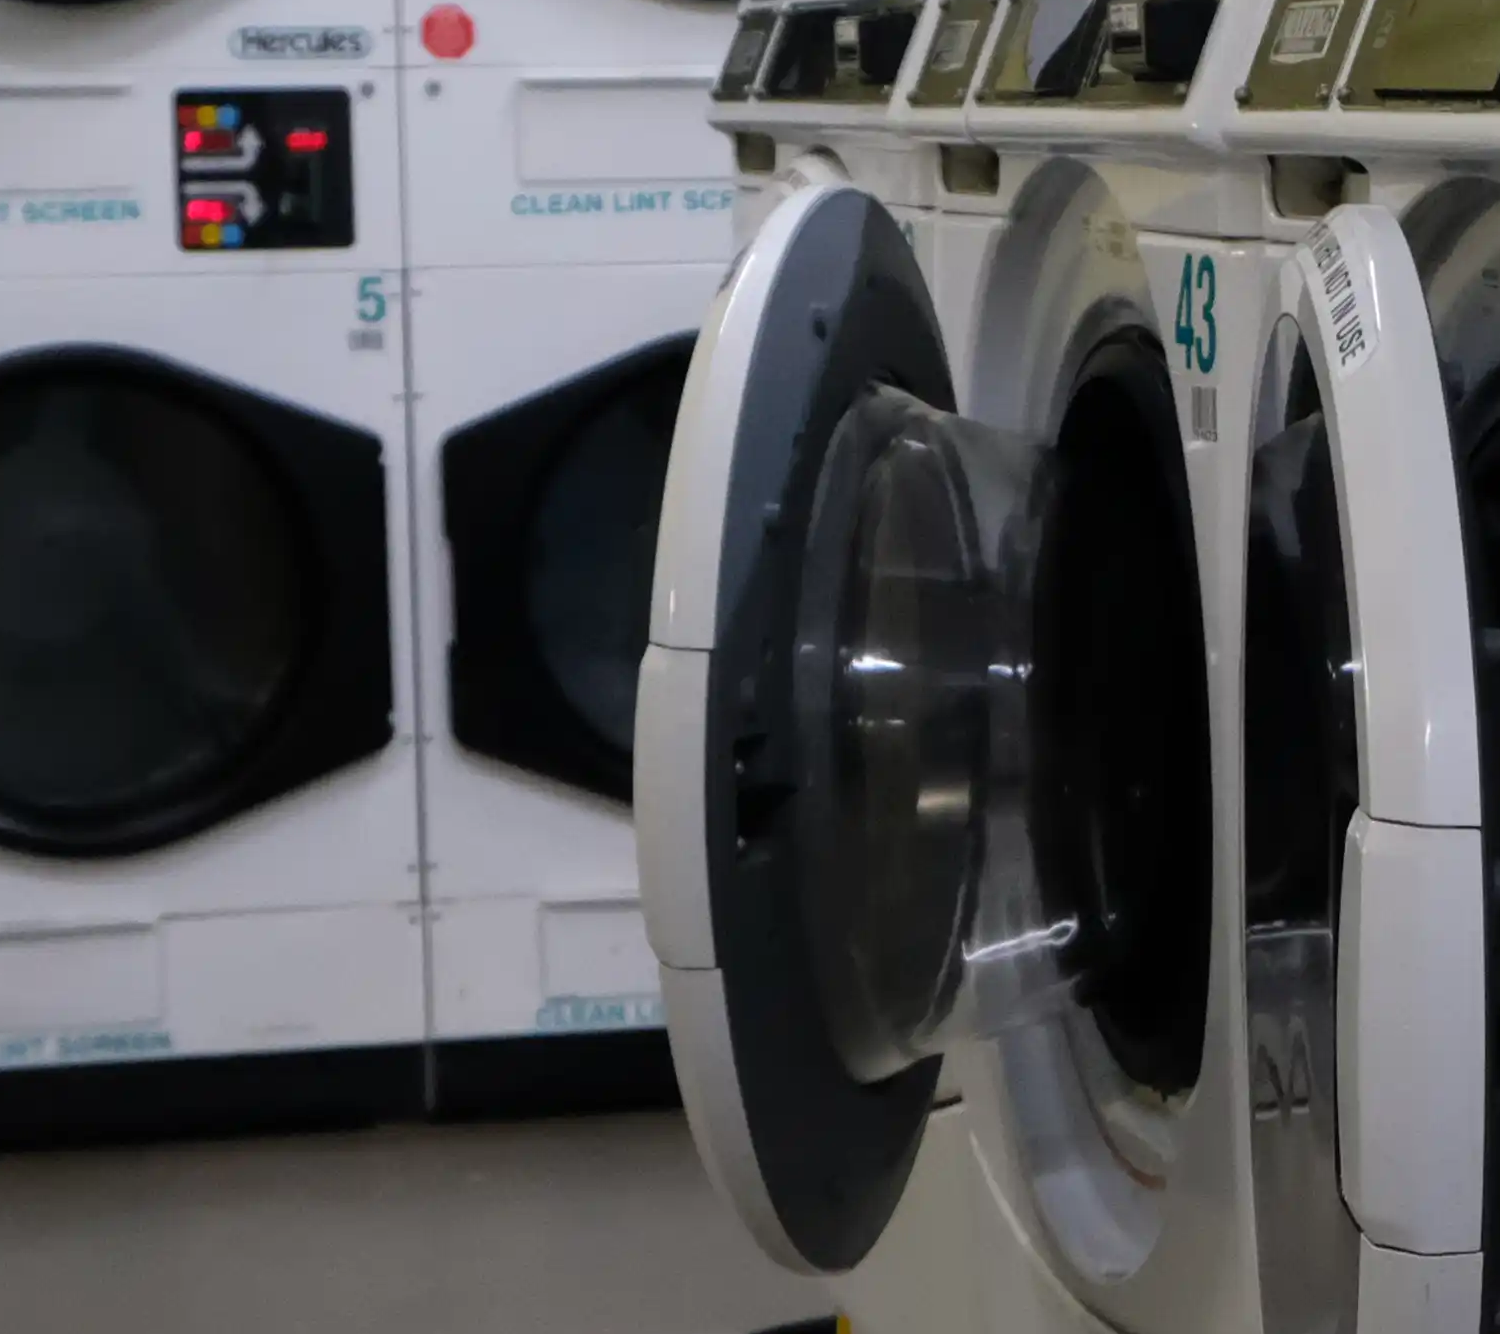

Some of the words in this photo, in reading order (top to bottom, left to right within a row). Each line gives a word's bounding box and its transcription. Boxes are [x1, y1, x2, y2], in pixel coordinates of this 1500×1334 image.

[21, 198, 141, 224] SCREEN
[510, 193, 604, 216] CLEAN
[612, 190, 672, 213] LINT
[357, 275, 387, 324] 5
[1323, 260, 1352, 303] NOT
[1175, 252, 1217, 375] 43
[1330, 291, 1357, 326] IN
[1335, 314, 1366, 367] USE
